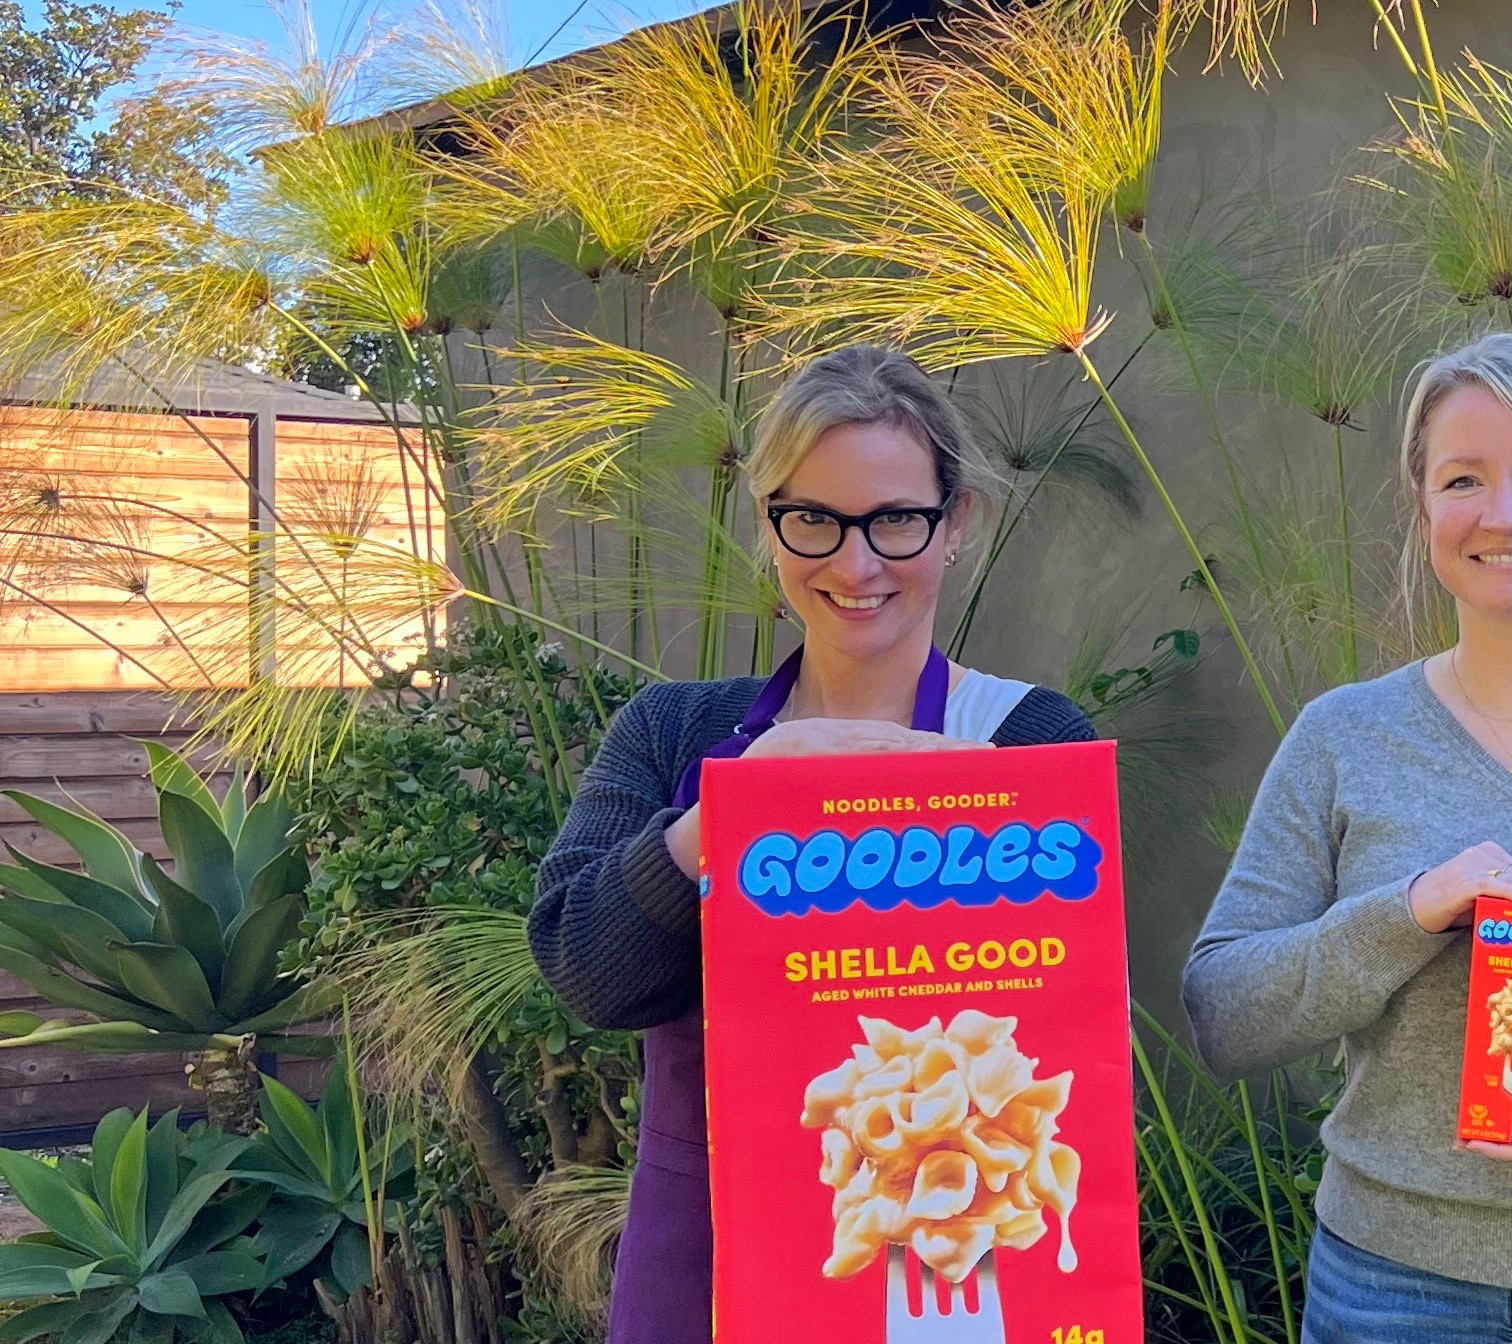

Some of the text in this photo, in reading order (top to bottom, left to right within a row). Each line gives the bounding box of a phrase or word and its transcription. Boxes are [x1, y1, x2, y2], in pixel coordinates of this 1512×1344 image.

[823, 796, 921, 814] NOODLES,
[740, 820, 1093, 906] GOODLES
[785, 937, 1066, 982] SHELLA GOOD
[811, 977, 1043, 1002] AGED WHITE CHEDDAR AND SHELLS
